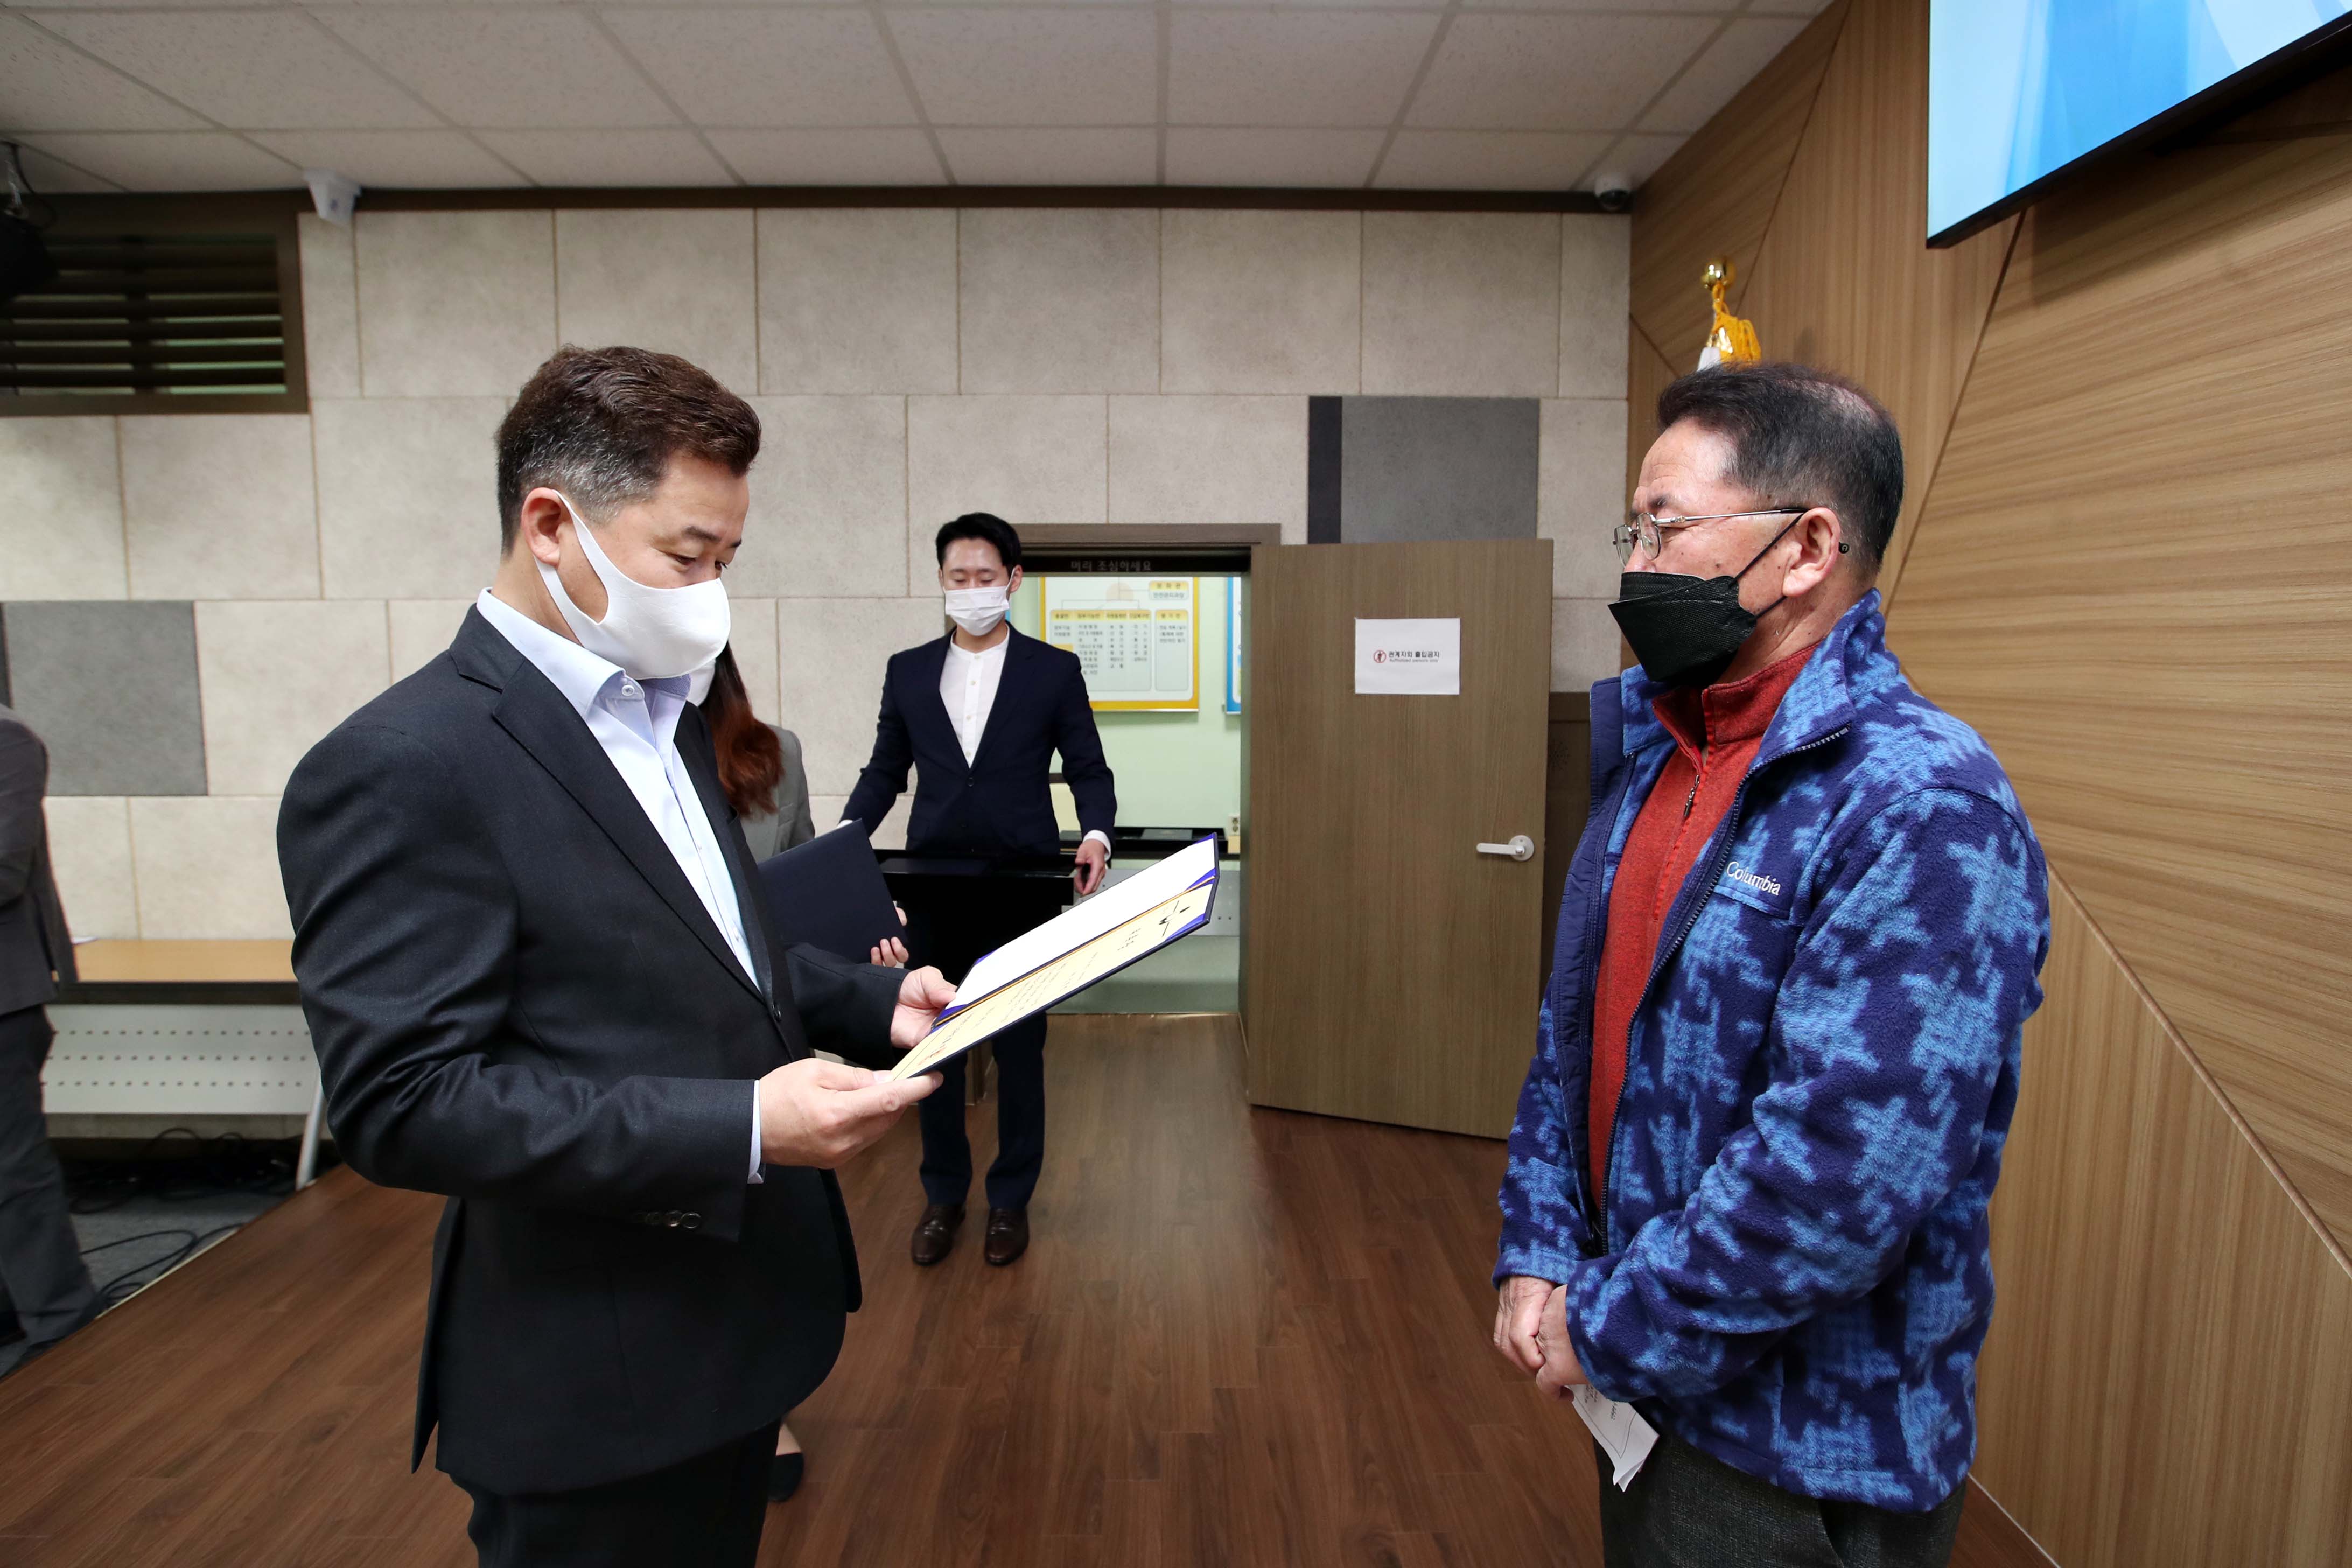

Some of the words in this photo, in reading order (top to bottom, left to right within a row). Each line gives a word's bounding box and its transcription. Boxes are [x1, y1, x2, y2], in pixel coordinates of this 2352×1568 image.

[1071, 561, 1092, 571] 머리
[1097, 561, 1152, 571] 조심하세요
[1726, 861, 1781, 895] Columbia
